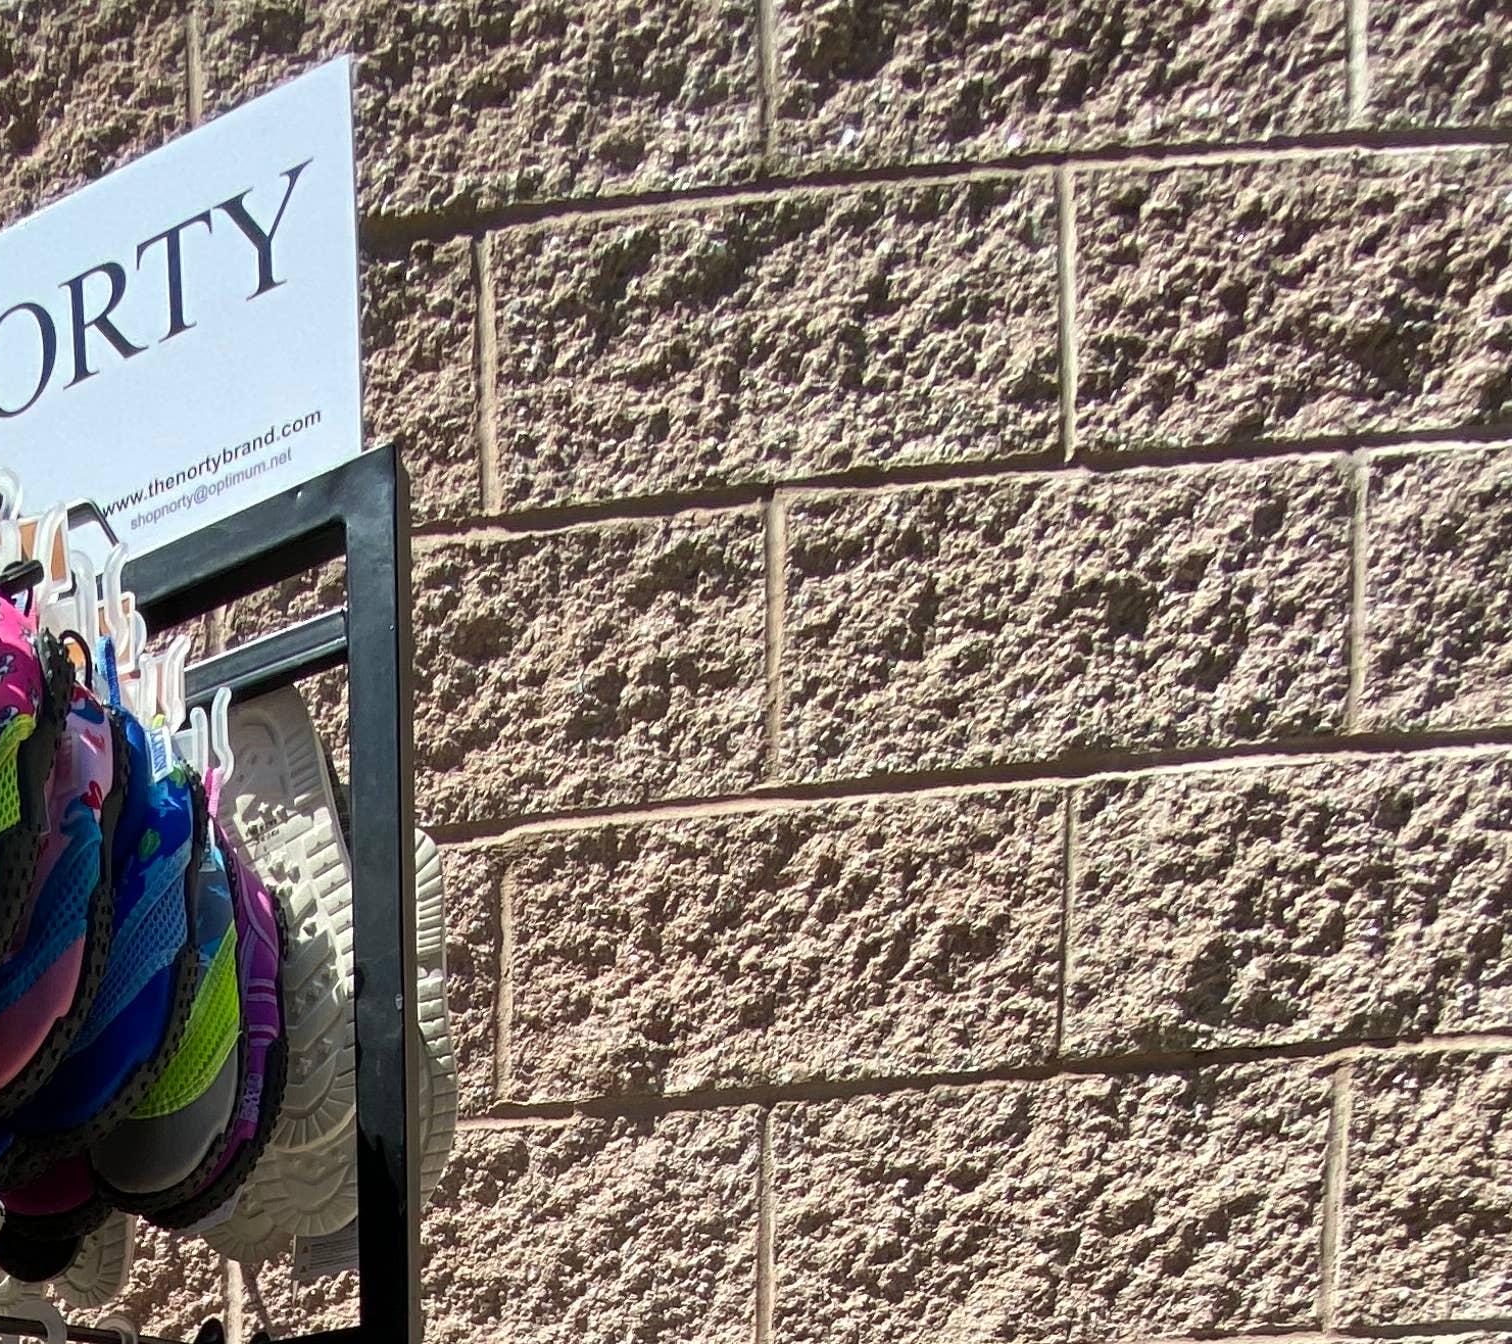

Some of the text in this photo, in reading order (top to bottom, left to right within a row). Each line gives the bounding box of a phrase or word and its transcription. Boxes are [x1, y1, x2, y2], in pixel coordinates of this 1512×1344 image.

[103, 410, 321, 519] www.thenortybrand.com
[131, 446, 292, 530] shopnorty@optimum.net
[150, 731, 167, 775] NORTY
